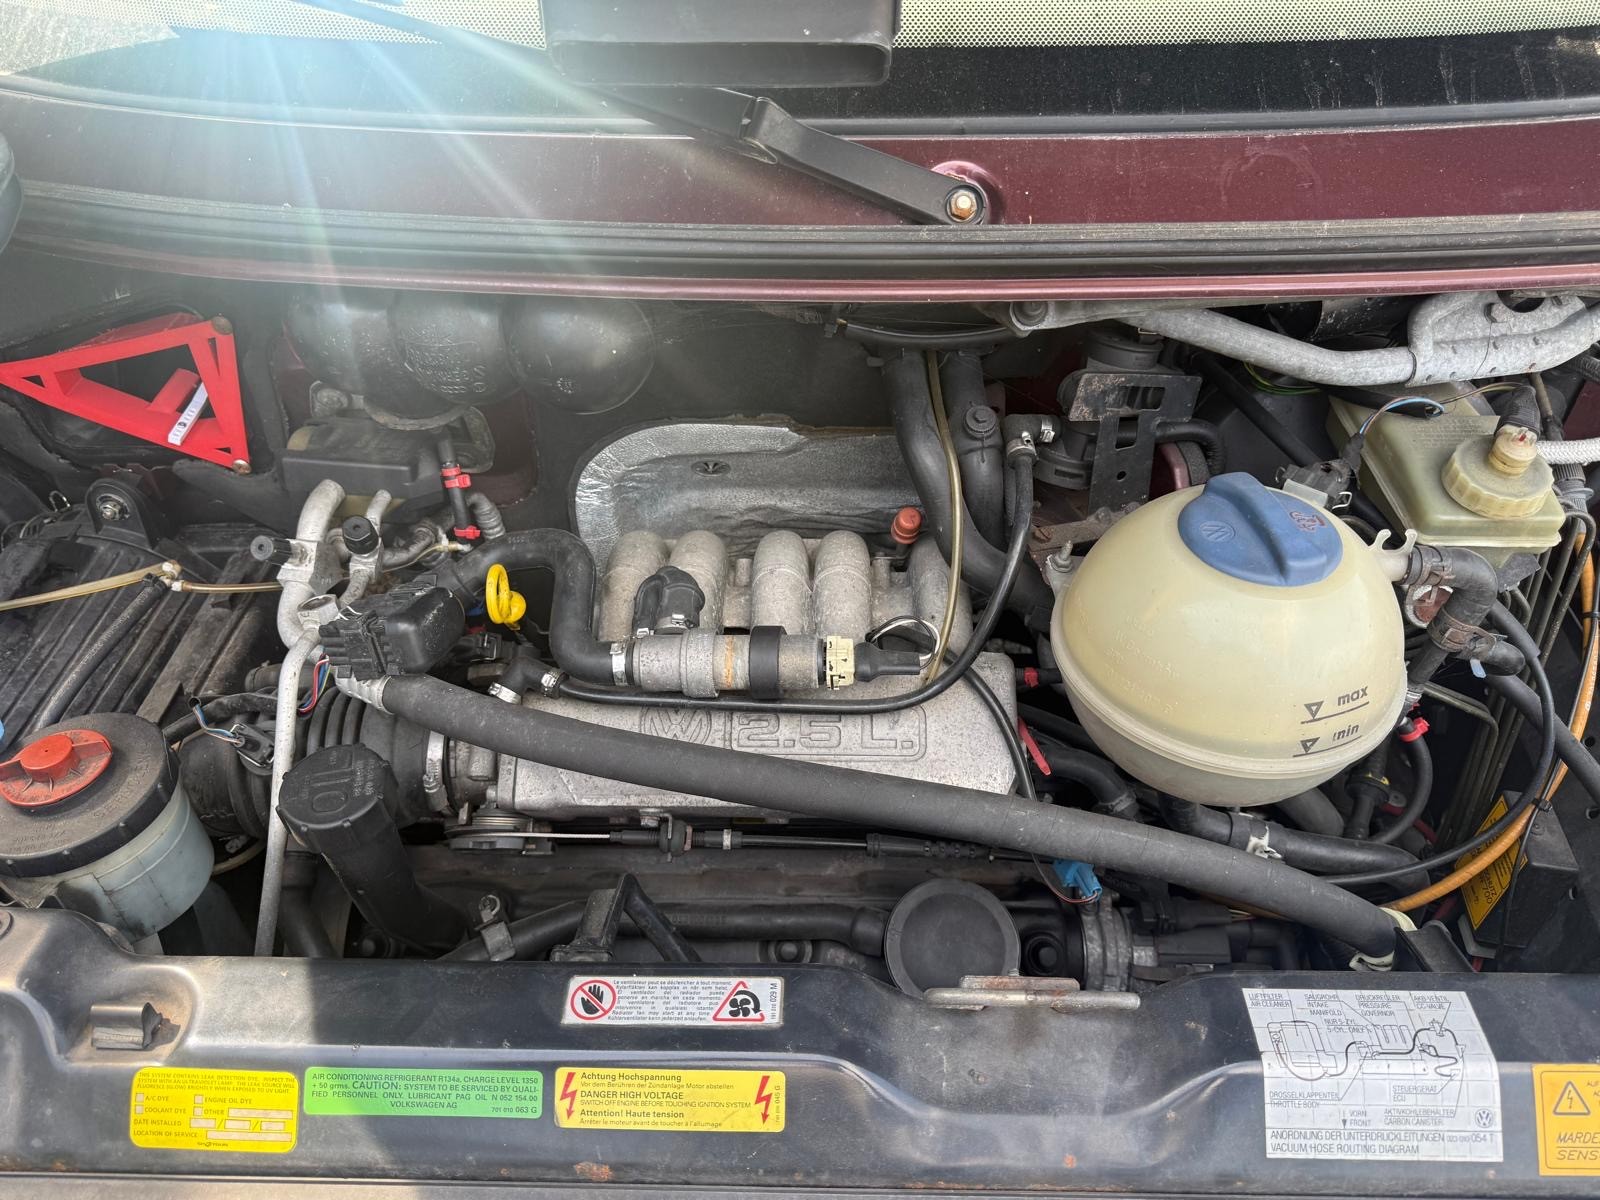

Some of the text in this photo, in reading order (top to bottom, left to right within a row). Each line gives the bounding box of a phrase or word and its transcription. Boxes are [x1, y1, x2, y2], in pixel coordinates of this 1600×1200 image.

[1337, 686, 1368, 706] max
[326, 1073, 383, 1081] CONDITIONING
[384, 1074, 437, 1082] REFRIGERANT
[497, 1076, 520, 1084] LEVEL
[581, 1072, 681, 1083] Achtung Hochspannung
[404, 1083, 436, 1091] SYSTEM
[333, 1091, 378, 1099] PERSONNEL
[408, 1092, 452, 1100] LUBRICANT
[580, 1090, 684, 1100] DANGER HIGH VOLTAGE
[390, 1101, 445, 1109] VOLKSWAGEN
[515, 1106, 529, 1114] 063
[531, 1106, 538, 1114] G
[580, 1109, 684, 1118] Attention! Haute tension
[1350, 1119, 1371, 1127] FRONT
[1384, 1117, 1443, 1126] CARBON CANISTER
[1271, 1131, 1323, 1140] ANORDNUNG
[1324, 1131, 1342, 1140] DER
[1472, 1133, 1487, 1142] 054
[1556, 1132, 1600, 1144] MARDE
[1271, 1143, 1419, 1154] VACUUM HOSE ROUTING DIAGRAM
[1557, 1150, 1600, 1161] SENS
